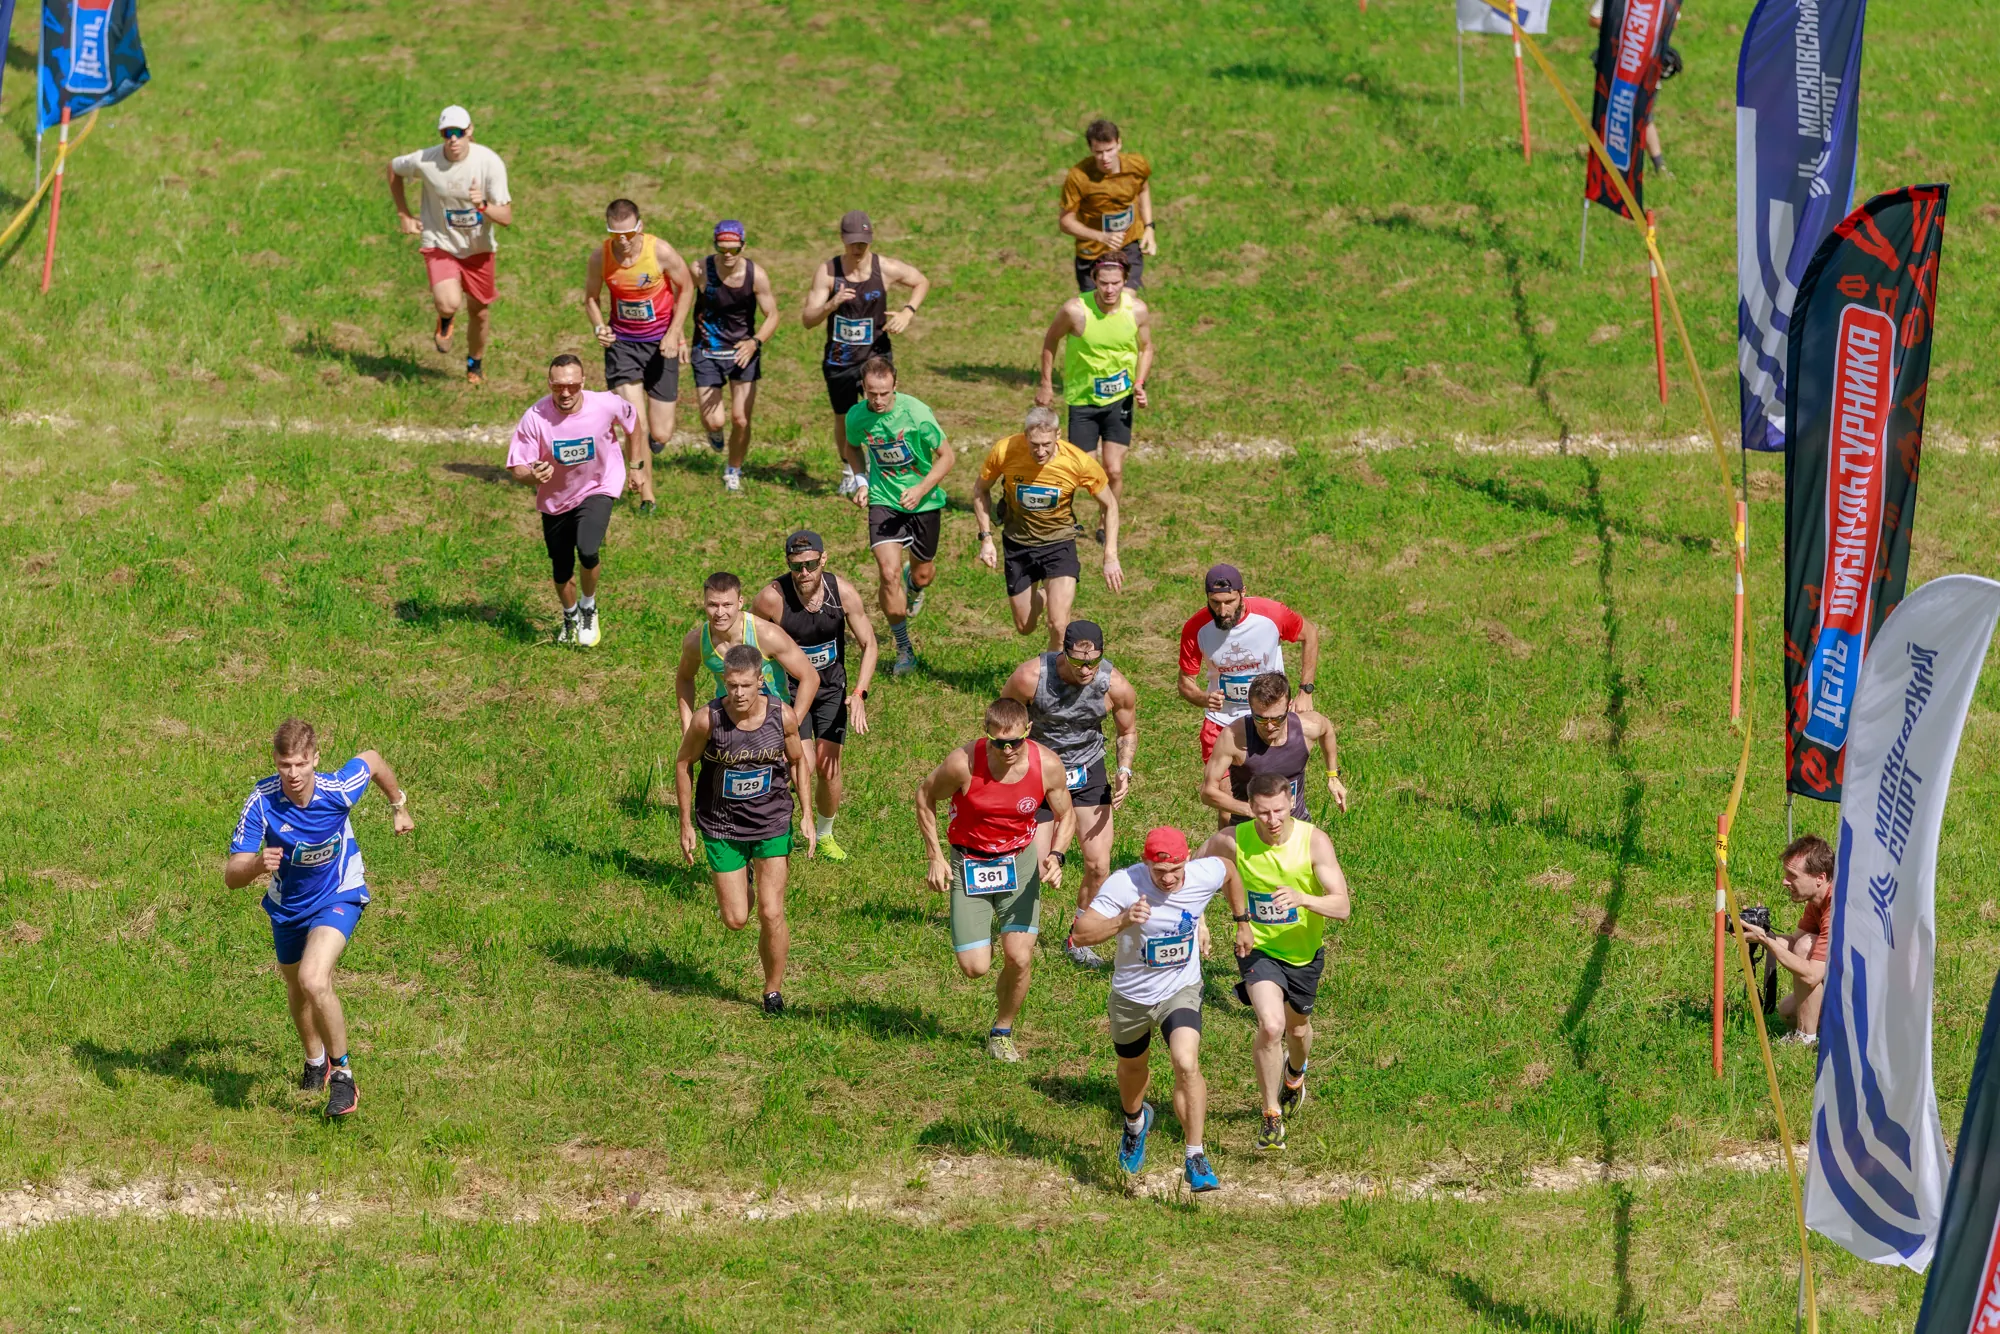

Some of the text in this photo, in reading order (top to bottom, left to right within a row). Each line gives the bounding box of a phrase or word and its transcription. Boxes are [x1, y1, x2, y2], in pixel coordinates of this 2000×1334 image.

[563, 447, 587, 458] 203
[882, 450, 900, 459] 411
[1812, 324, 1881, 729] ДЕНЬ ФИЗКУЛЬТУРНИКА
[808, 654, 827, 665] 55
[1874, 641, 1939, 849] МОСКОВСКИЙ
[737, 780, 760, 791] 129
[1888, 759, 1923, 866] СПОРТ
[303, 849, 331, 861] 200
[978, 870, 1003, 883] 361
[1160, 946, 1184, 958] 391
